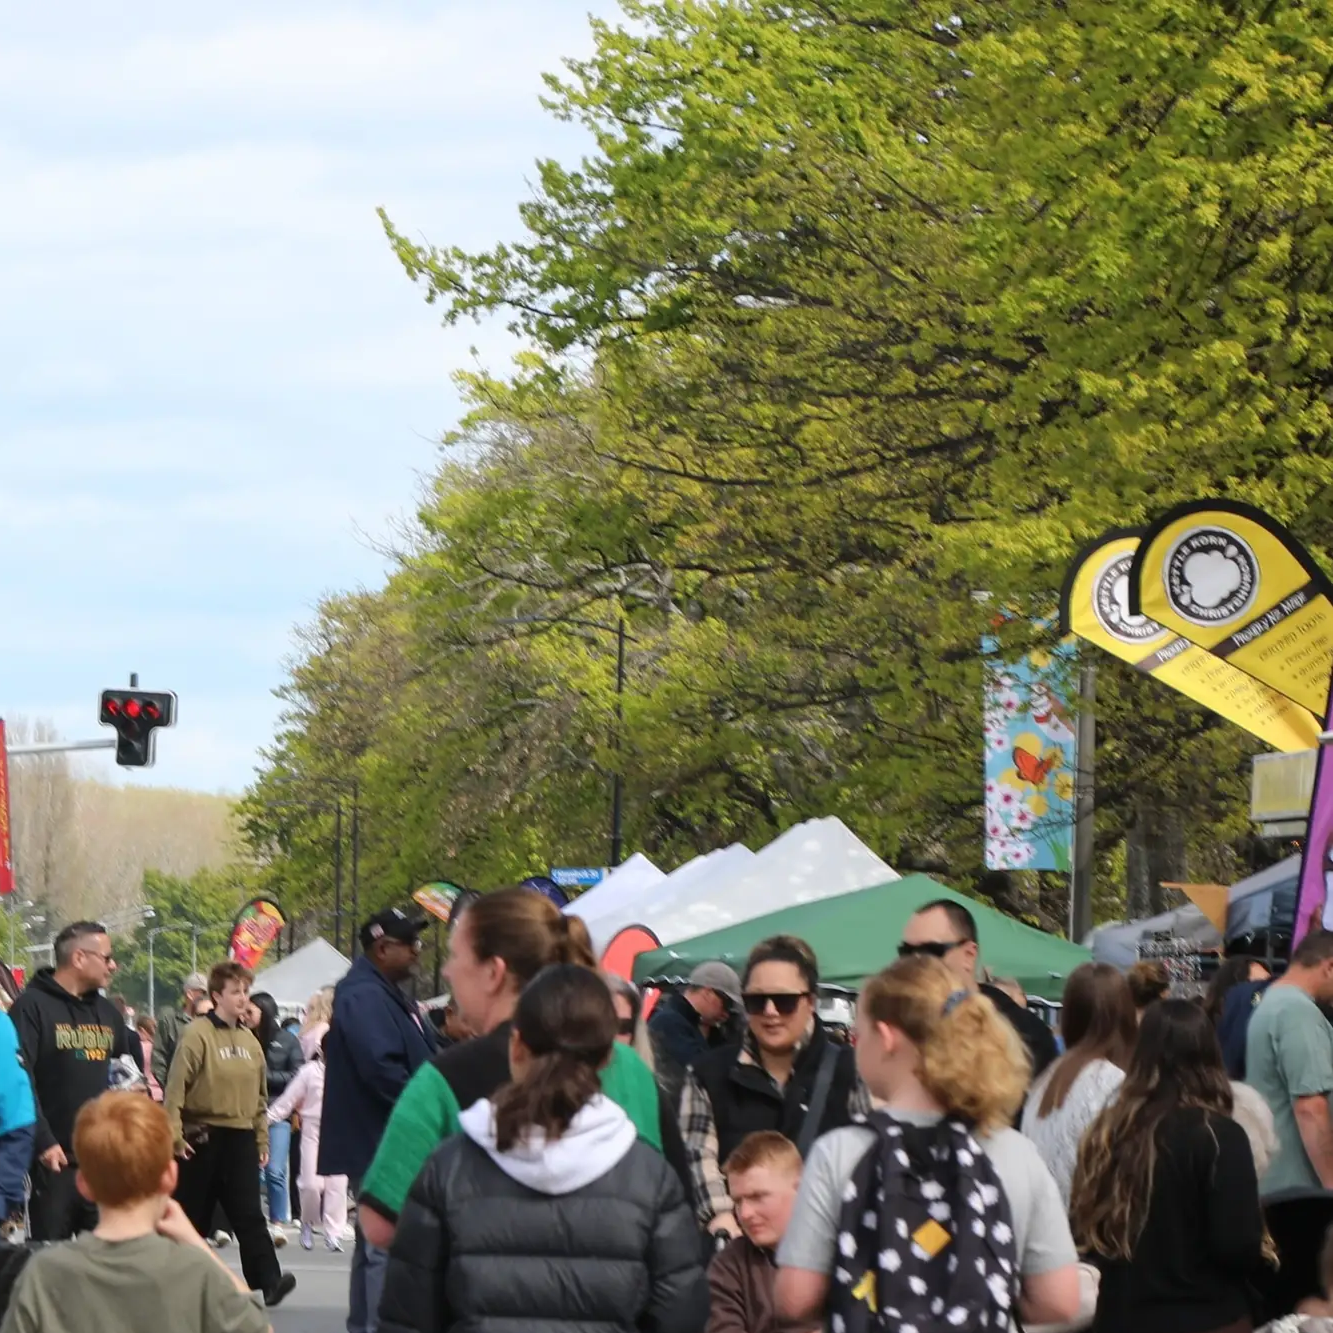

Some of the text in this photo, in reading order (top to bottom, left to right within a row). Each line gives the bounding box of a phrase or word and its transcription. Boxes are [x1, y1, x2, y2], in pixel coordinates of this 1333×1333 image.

[1171, 534, 1228, 595] KETTLE KORN
[55, 1029, 115, 1052] RUGBY
